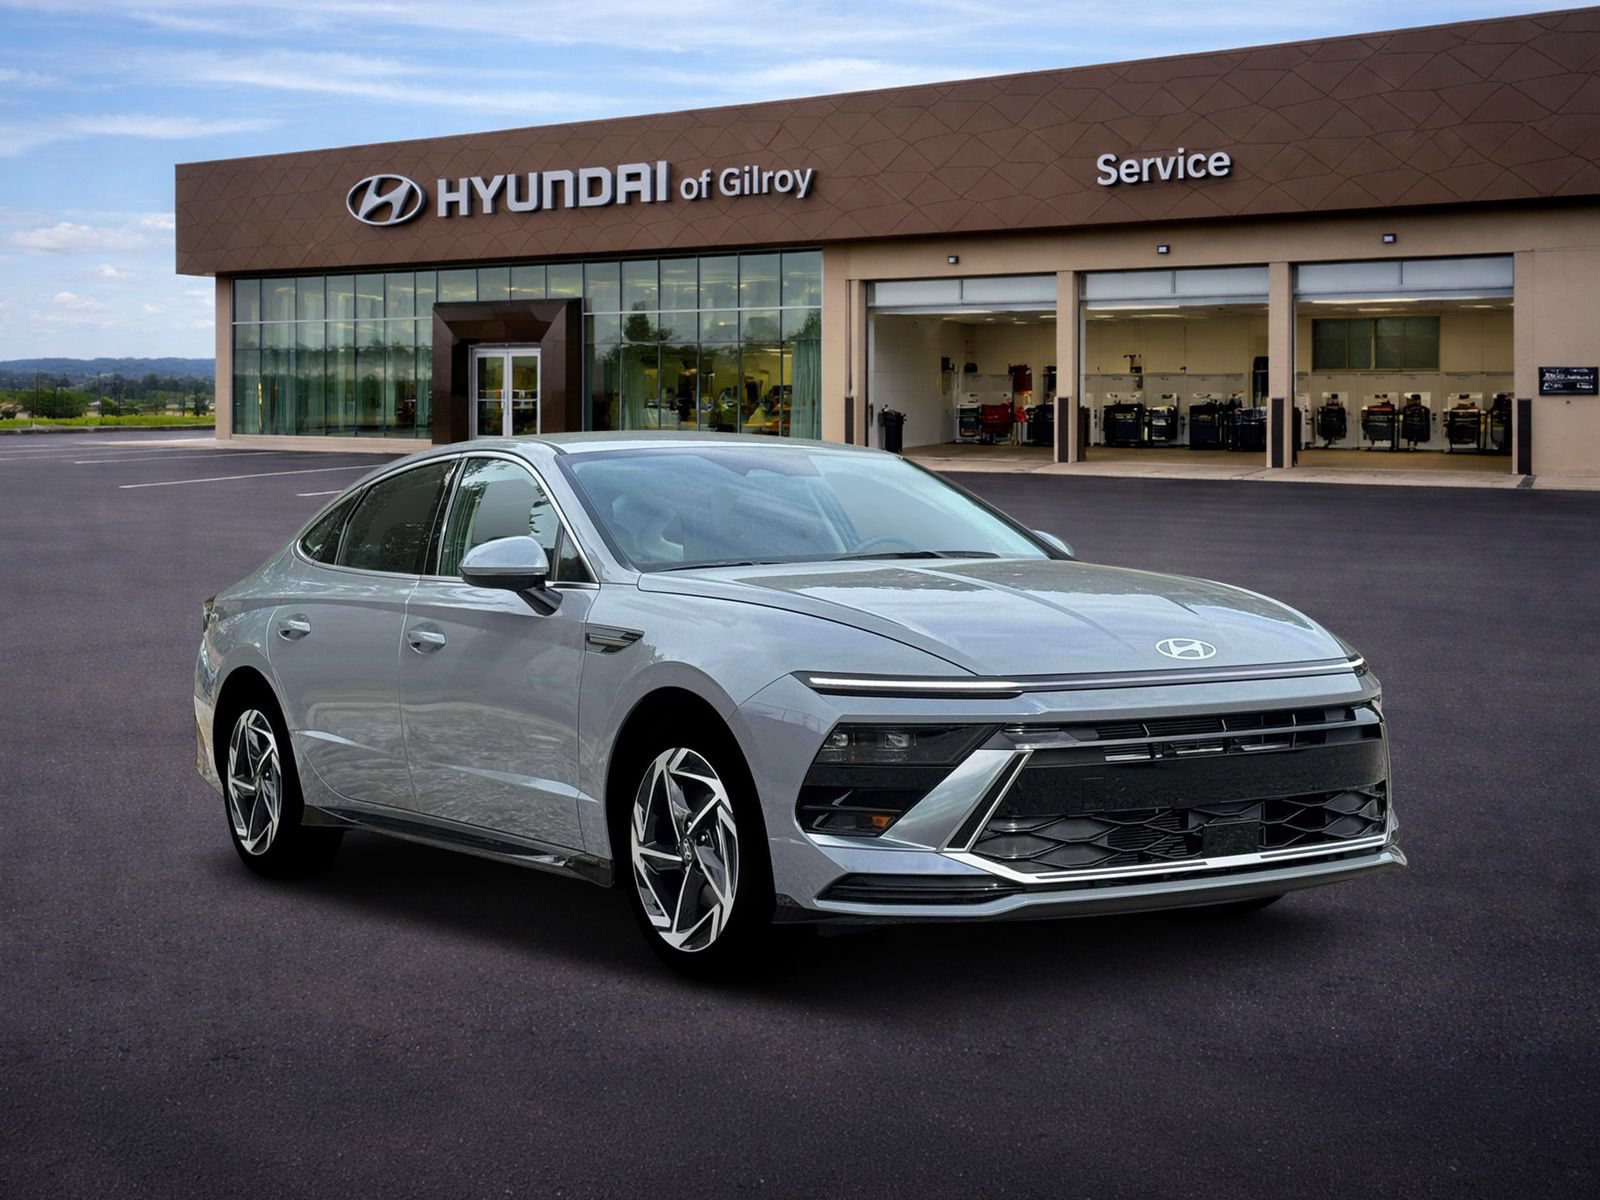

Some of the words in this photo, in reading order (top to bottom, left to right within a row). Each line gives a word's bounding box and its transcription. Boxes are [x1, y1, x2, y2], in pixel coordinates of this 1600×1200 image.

[436, 160, 669, 218] HYUNDAI
[679, 169, 711, 201] of
[718, 165, 814, 200] Gilroy
[1096, 147, 1232, 187] Service
